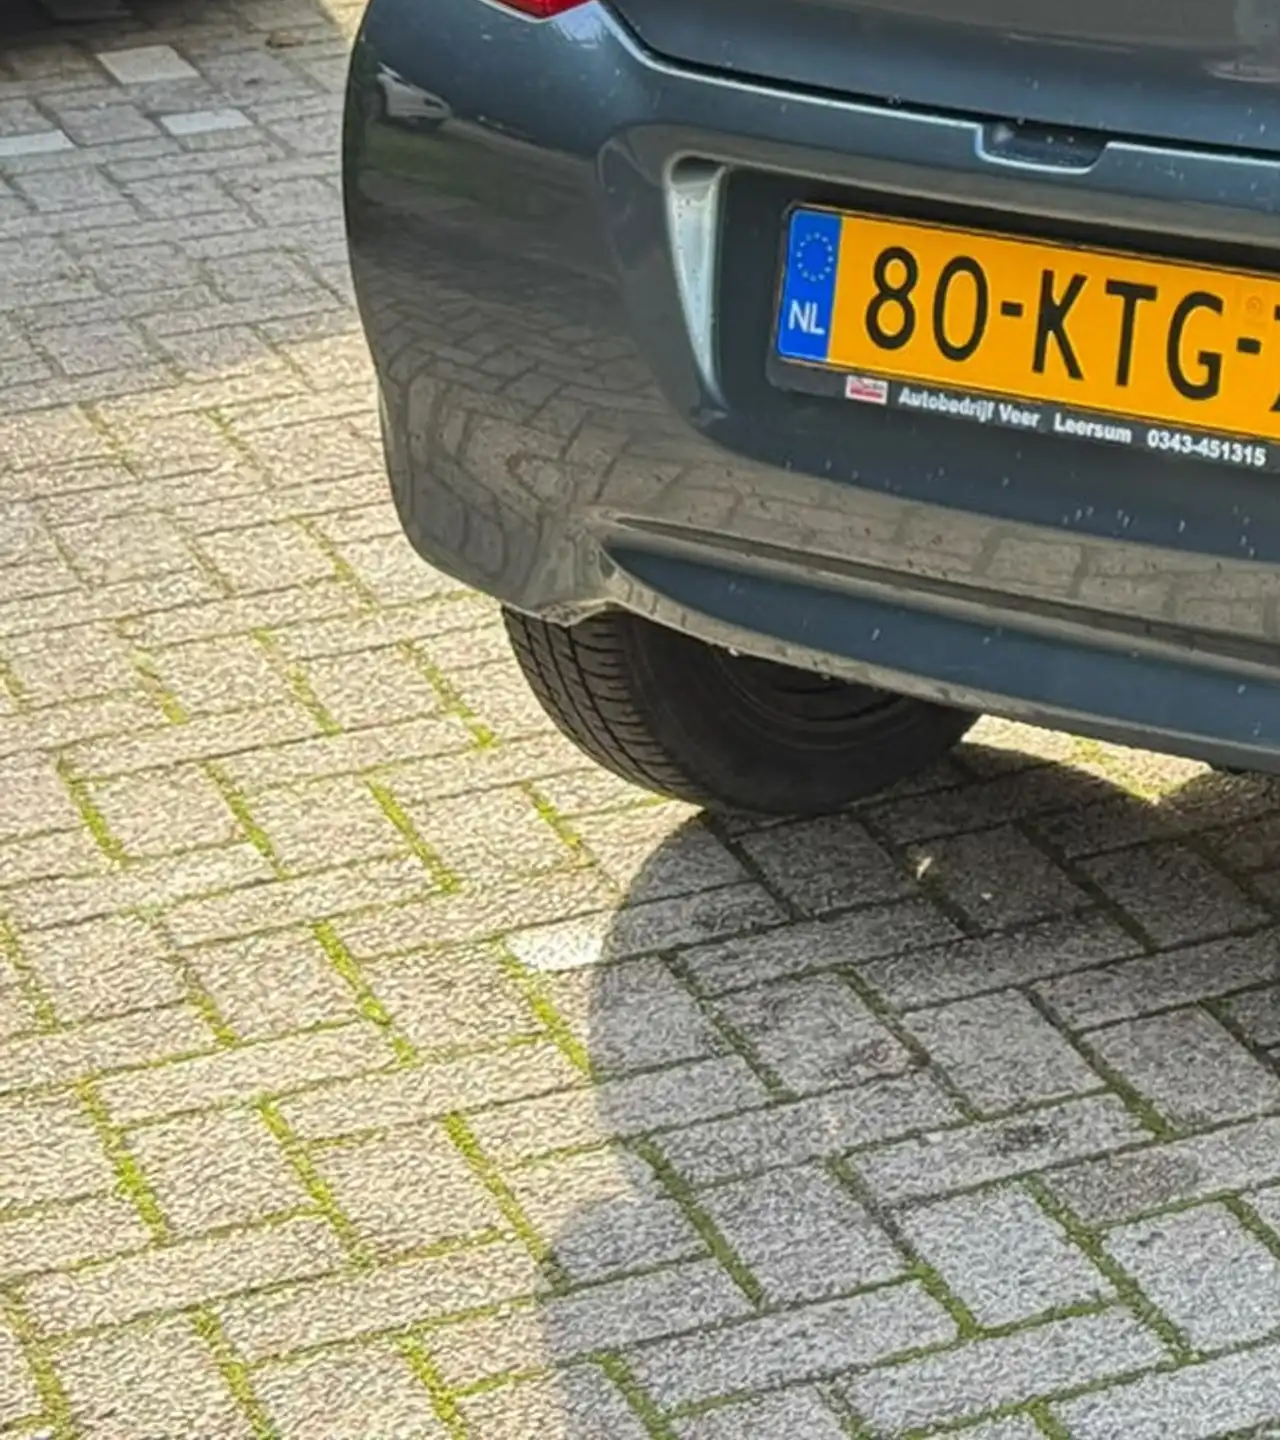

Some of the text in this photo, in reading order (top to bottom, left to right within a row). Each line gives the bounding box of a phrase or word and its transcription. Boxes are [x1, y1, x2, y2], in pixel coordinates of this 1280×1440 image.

[787, 298, 826, 336] NL
[897, 386, 996, 423] Autobedrijf
[999, 403, 1041, 428] Veer
[1053, 412, 1133, 445] Leersum
[1146, 429, 1267, 467] 0343-451315
